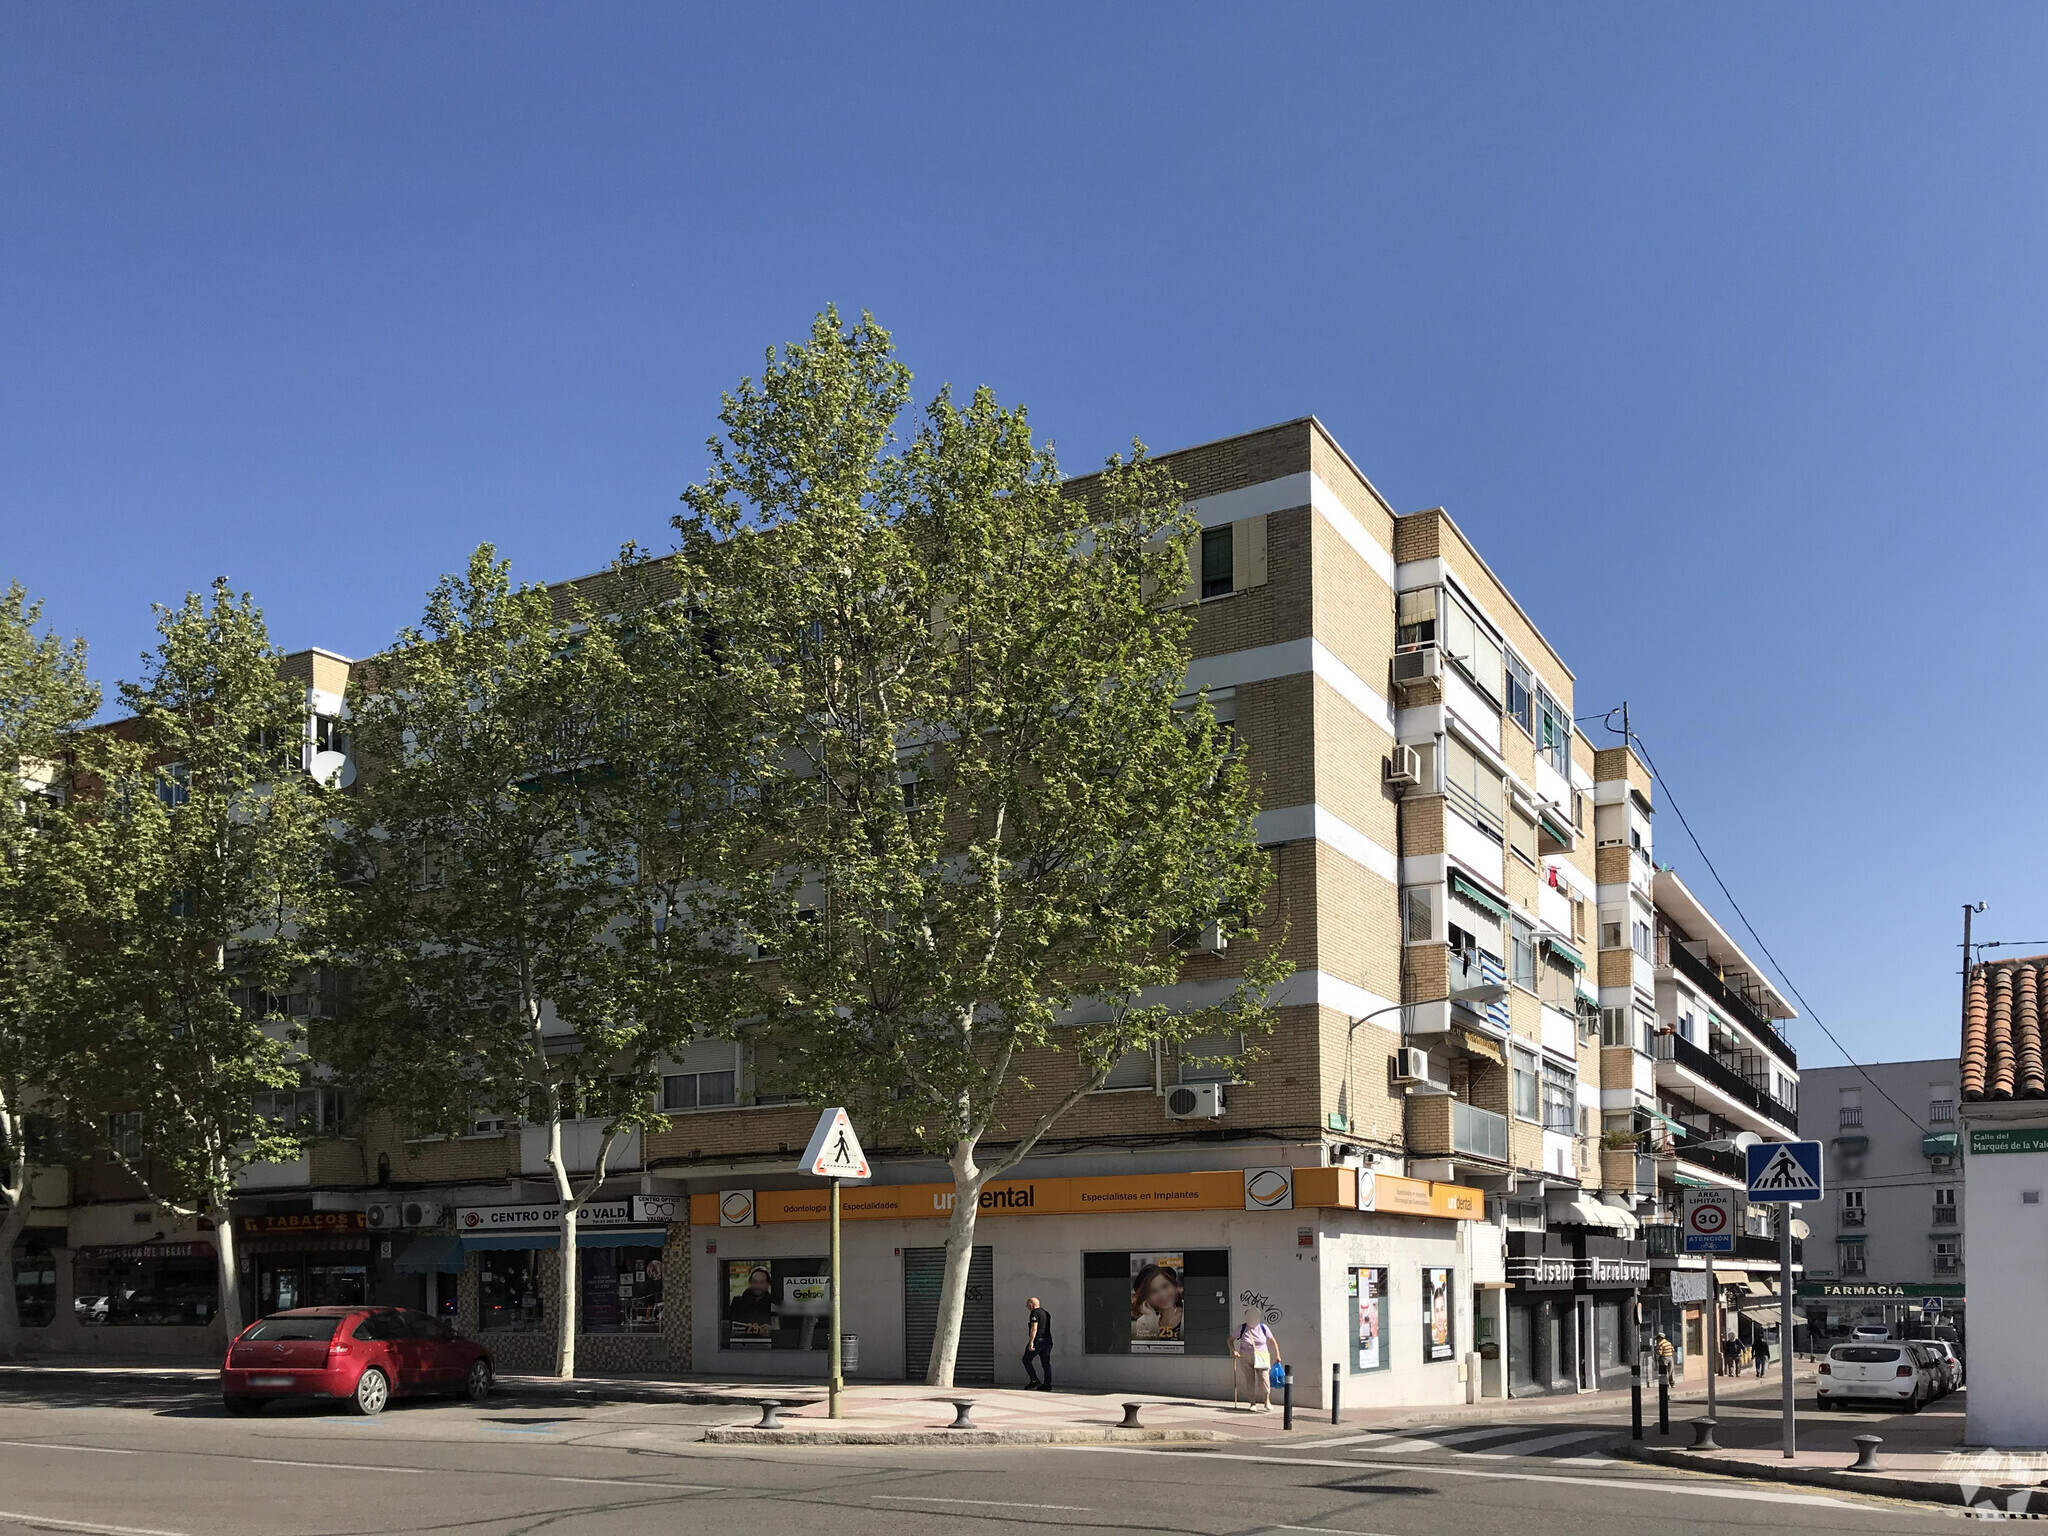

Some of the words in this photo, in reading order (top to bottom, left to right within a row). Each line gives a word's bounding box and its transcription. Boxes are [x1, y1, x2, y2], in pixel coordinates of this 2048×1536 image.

[1973, 1142, 2009, 1152] Marqués
[2010, 1141, 2021, 1150] de
[2023, 1141, 2031, 1149] la
[1081, 1193, 1138, 1202] Especialistas
[1154, 1191, 1199, 1200] Implantes
[842, 1202, 898, 1211] Especialidades
[265, 1214, 347, 1226] TABACOS
[490, 1211, 539, 1223] CENTRO
[1698, 1214, 1718, 1224] 30
[1535, 1255, 1576, 1281] diseño
[1824, 1286, 1905, 1295] FARMACIA
[1159, 1325, 1174, 1338] 25
